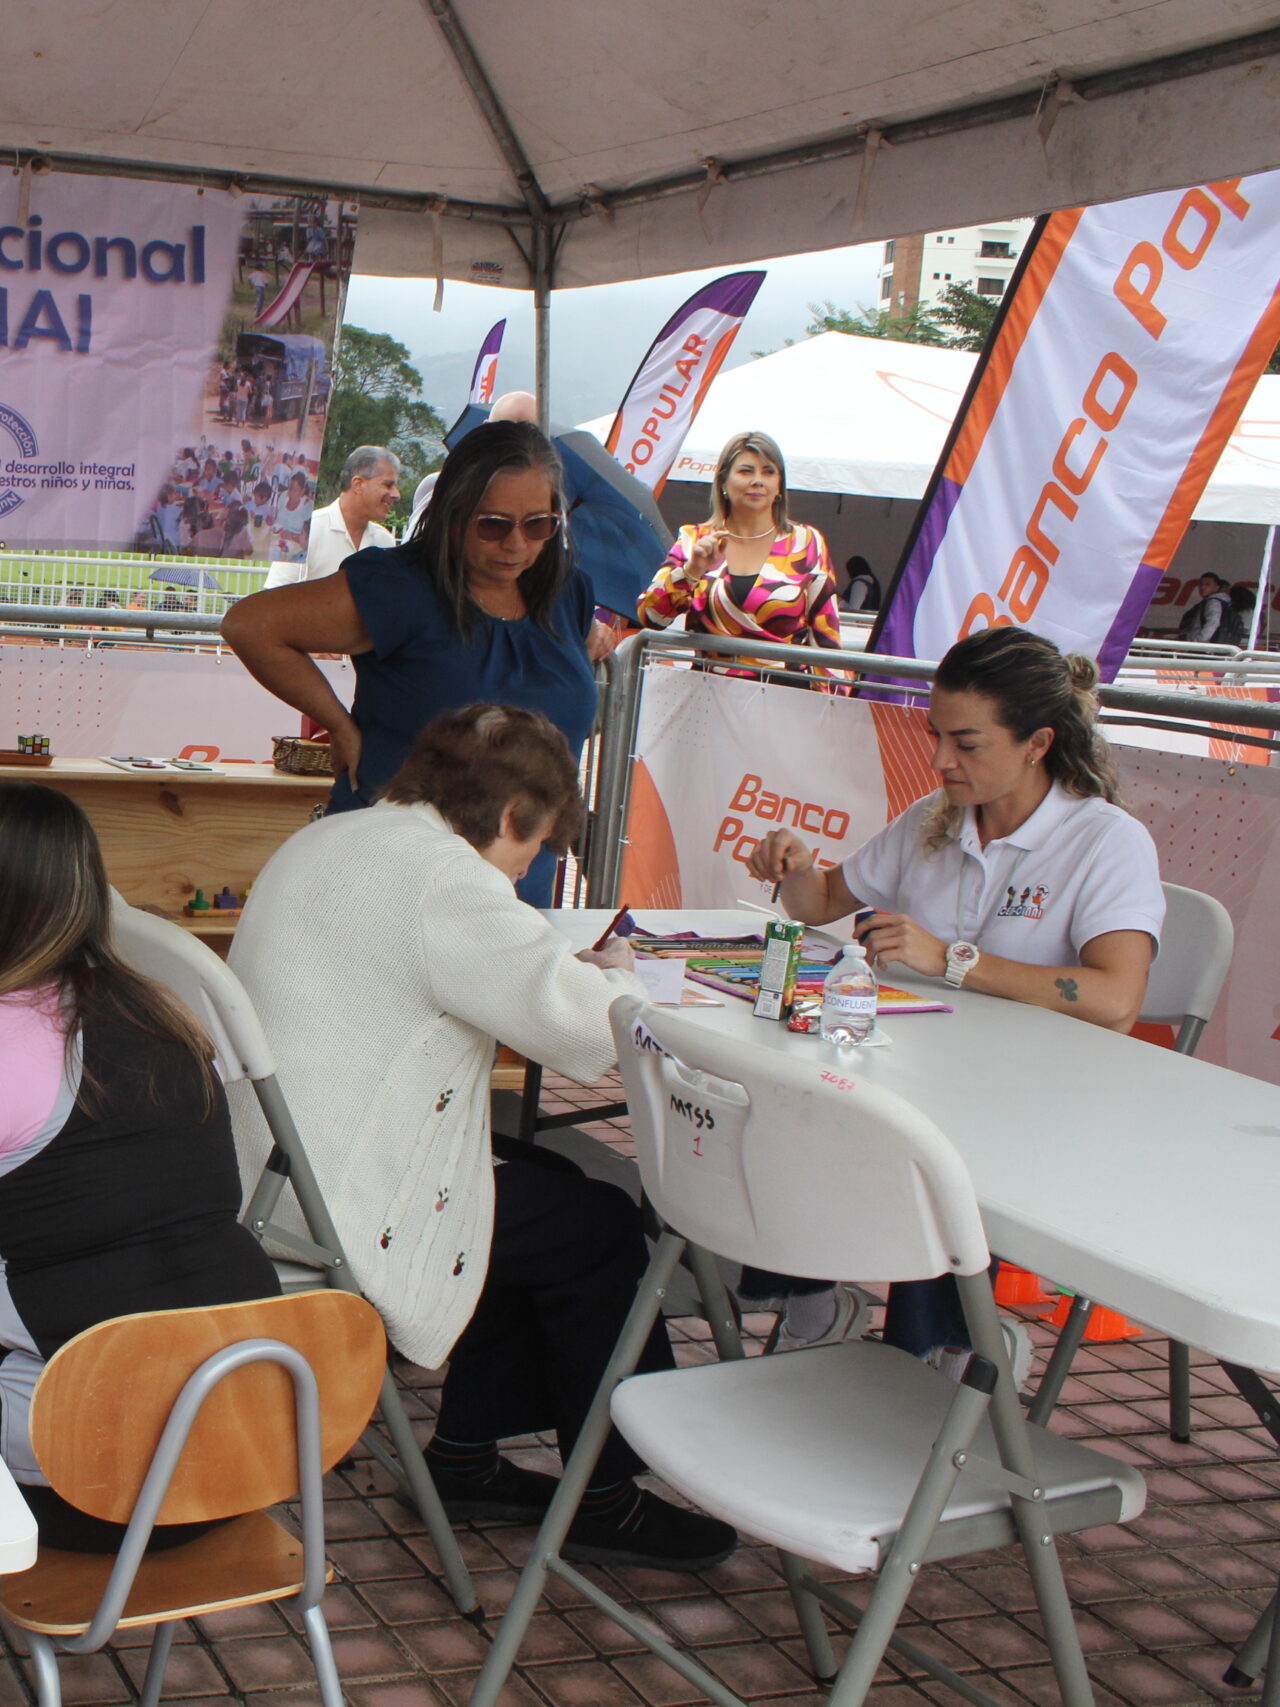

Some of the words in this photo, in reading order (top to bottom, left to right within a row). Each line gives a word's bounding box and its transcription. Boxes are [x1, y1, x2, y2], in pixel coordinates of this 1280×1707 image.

[5, 459, 75, 475] desarrollo
[79, 461, 136, 479] integral
[40, 475, 78, 489] niños
[81, 478, 91, 491] y
[94, 475, 135, 491] niñas.
[728, 773, 851, 841] Banco
[635, 1025, 671, 1059] MT
[670, 1093, 715, 1130] MTSS
